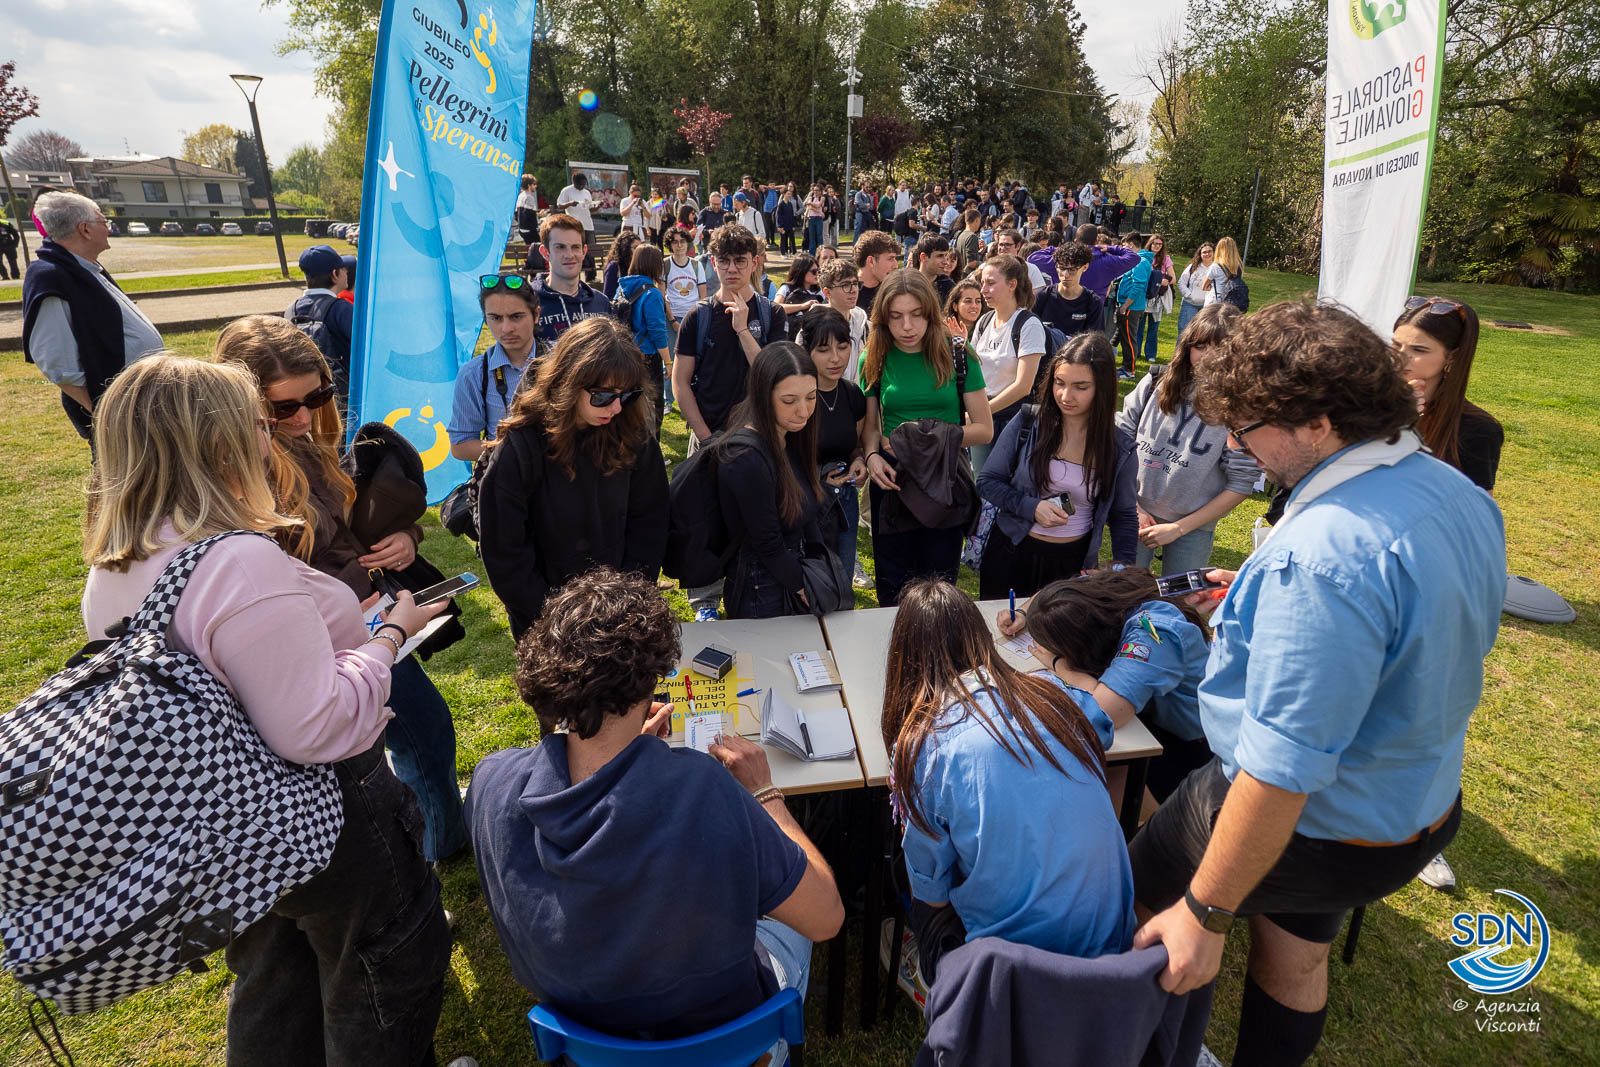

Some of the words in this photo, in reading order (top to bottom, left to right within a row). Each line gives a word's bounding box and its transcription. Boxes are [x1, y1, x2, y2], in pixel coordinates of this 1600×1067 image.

[412, 7, 471, 58] GIUBILEO
[424, 41, 454, 70] 2025
[408, 58, 508, 142] Pellegrini
[414, 98, 422, 112] di
[421, 104, 520, 177] Speranza
[1140, 441, 1165, 457] Viral
[1166, 449, 1189, 467] Vibes
